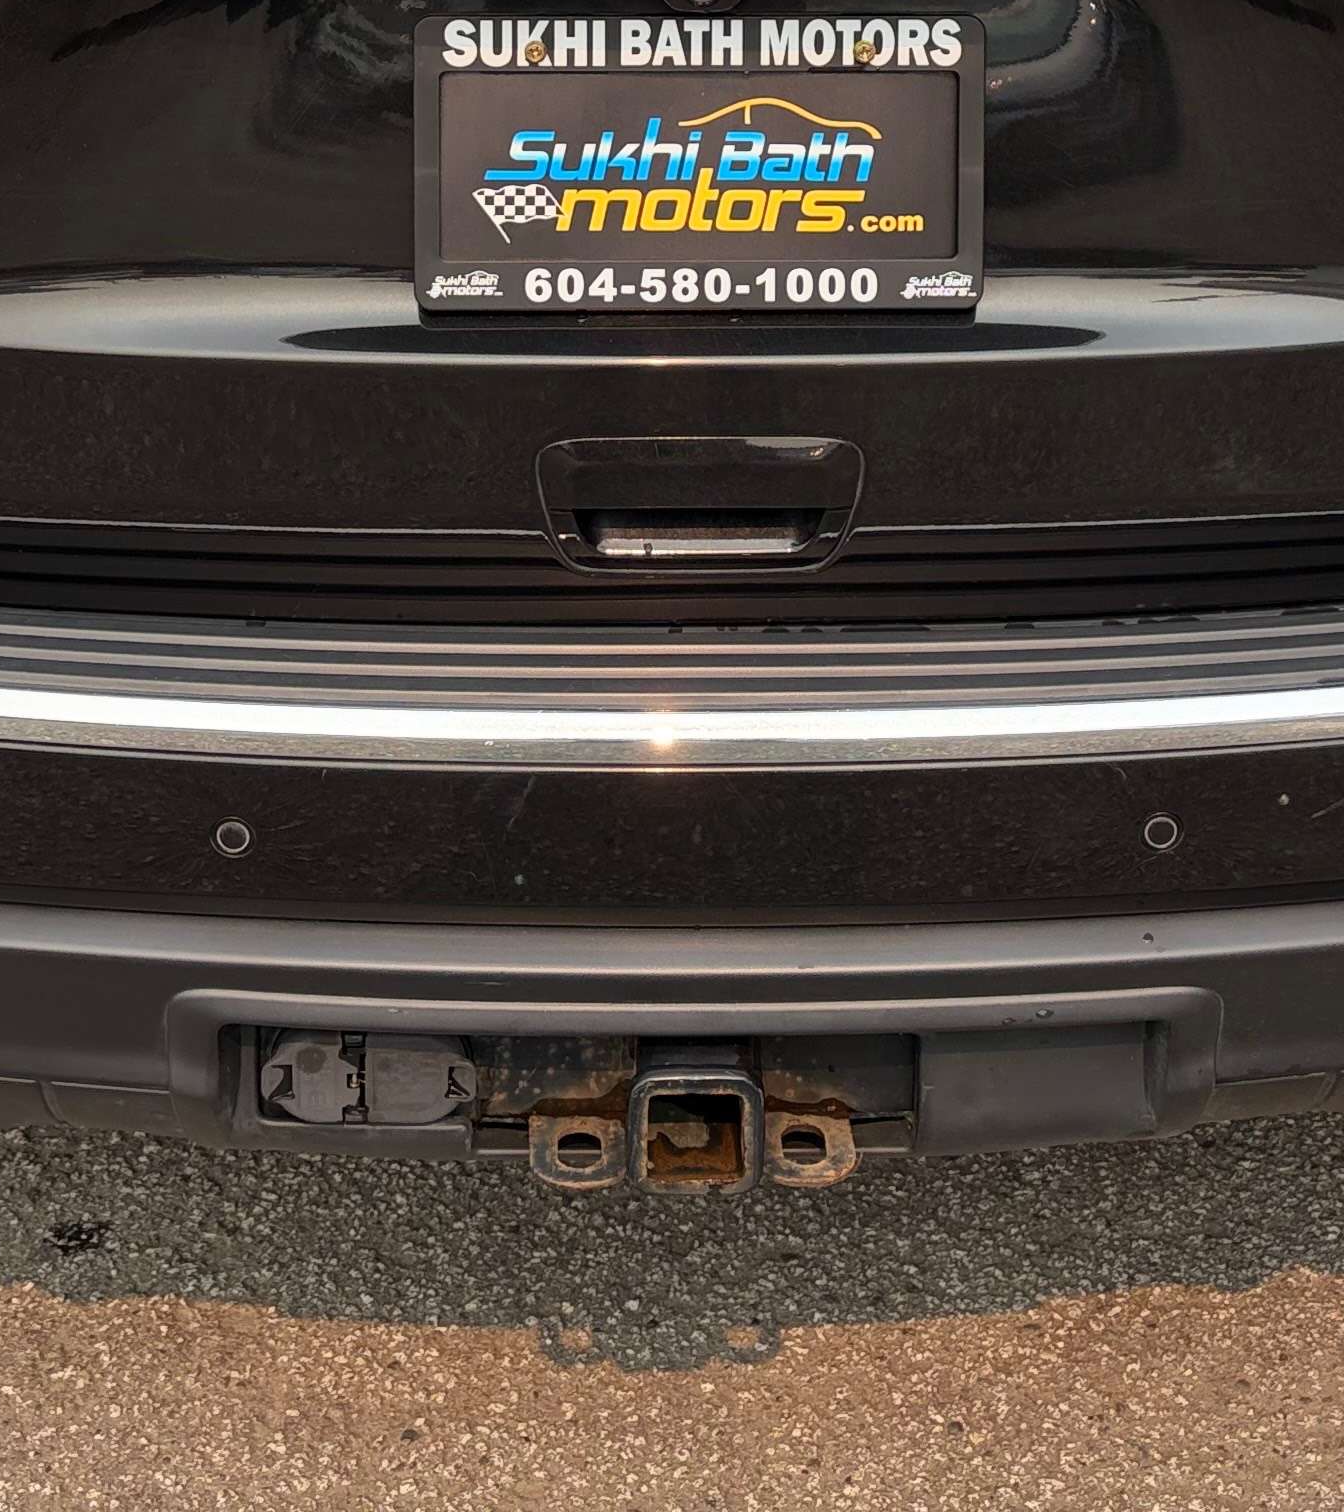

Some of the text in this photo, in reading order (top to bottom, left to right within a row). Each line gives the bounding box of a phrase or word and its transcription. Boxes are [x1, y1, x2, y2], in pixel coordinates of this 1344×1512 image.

[442, 18, 963, 68] SUKHI BATH MOTORS
[484, 117, 875, 182] Sukhi Bath
[524, 268, 878, 303] 604-580-1000
